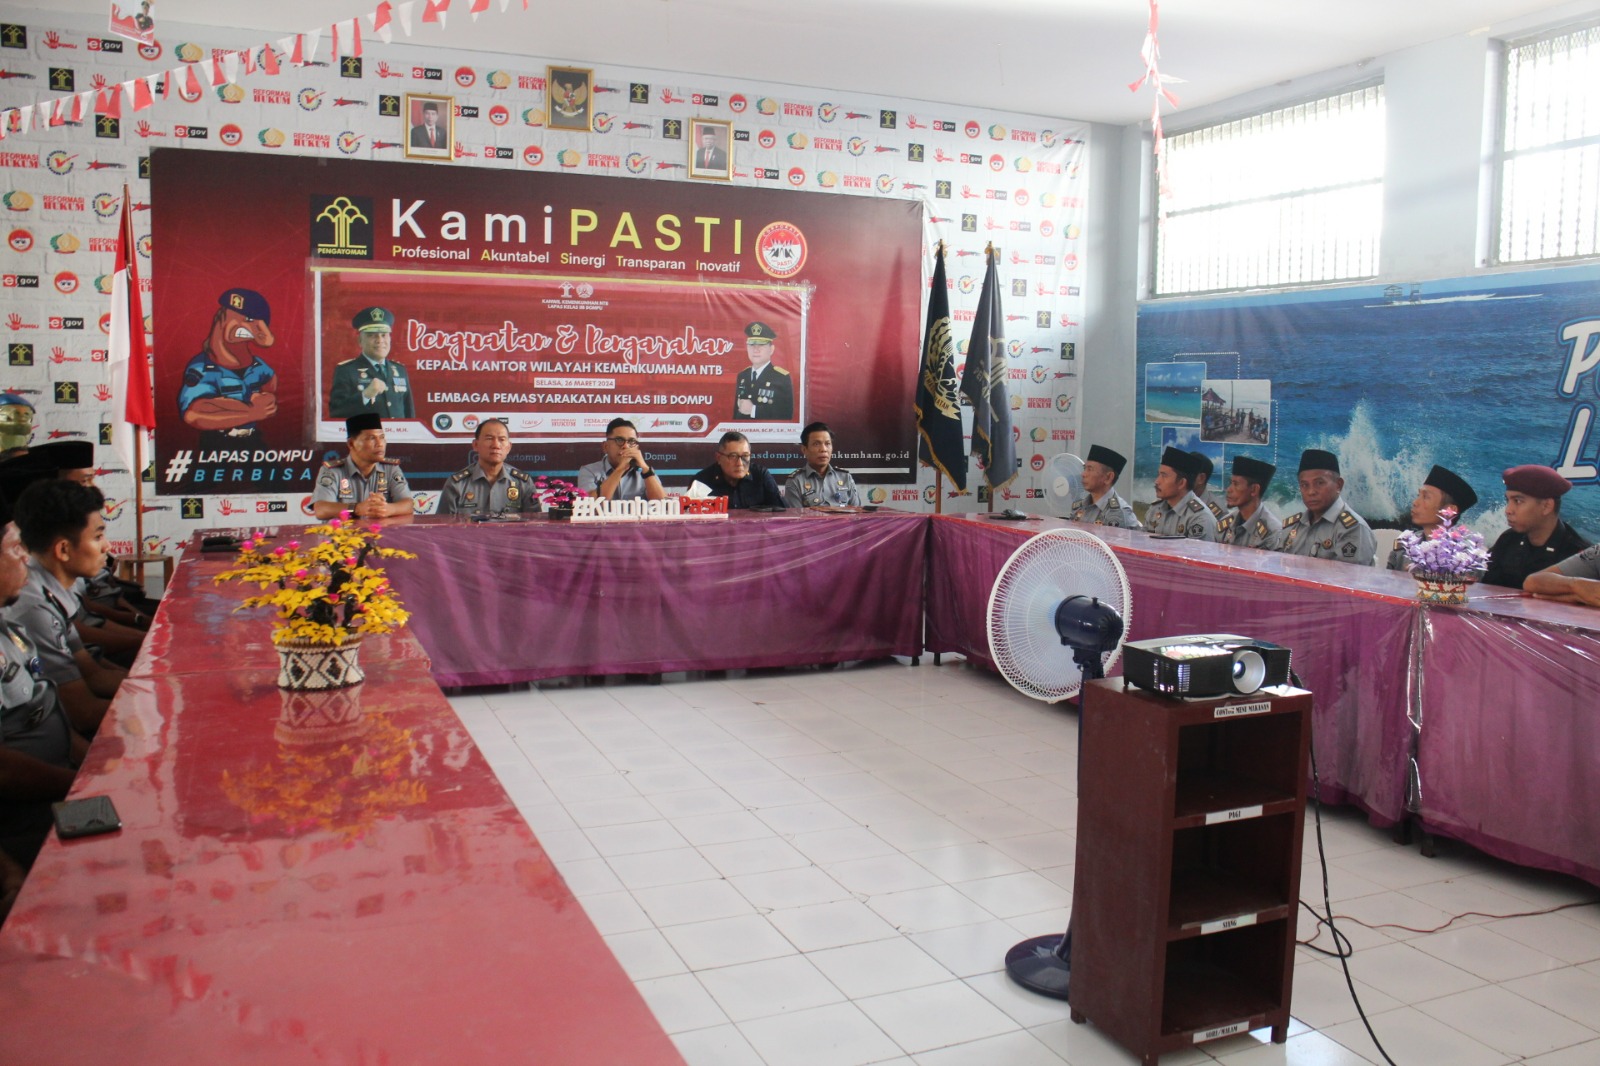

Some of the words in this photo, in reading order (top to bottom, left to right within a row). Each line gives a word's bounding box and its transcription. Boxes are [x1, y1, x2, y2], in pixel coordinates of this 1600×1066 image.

[518, 75, 547, 83] REFORMA
[518, 81, 547, 91] HUKU
[253, 88, 291, 97] REFORMASI
[253, 95, 291, 105] HUKUM
[784, 102, 813, 111] REFORMASI
[784, 109, 813, 118] HUKUM
[293, 132, 331, 141] REFORMASI
[813, 137, 843, 146] REFORMASI
[293, 139, 331, 149] HUKUM
[813, 143, 843, 152] HUKUM
[588, 153, 621, 163] REFORMASI
[588, 160, 621, 169] HUKUM
[843, 174, 872, 183] REFORMASI
[843, 180, 872, 189] HUKUM
[43, 194, 85, 204] REFORMASI
[43, 201, 85, 212] HUKUM
[392, 198, 554, 245] Kami
[570, 208, 743, 256] PASTI
[317, 247, 368, 256] PENGAYOMAN
[392, 245, 470, 261] Profesional
[480, 249, 550, 264] Akuntabel
[560, 252, 606, 268] Sinergi
[616, 255, 686, 271] Transparan
[695, 260, 741, 273] Inovatif
[416, 359, 469, 372] KEPALA
[472, 360, 527, 373] KANTOR
[530, 361, 591, 374] WILAYAH
[594, 362, 697, 376] KEMENKUMHAM
[699, 364, 723, 376] NTB
[535, 379, 564, 388] SELASA,
[598, 380, 614, 388] 2024
[427, 392, 490, 403] LEMBAGA
[493, 393, 611, 404] PEMASYARAKATAN
[614, 394, 651, 405] KELAS
[653, 395, 667, 405] IIB
[670, 395, 713, 406] DOMPU
[198, 450, 250, 464] LAPAS
[252, 449, 314, 463] DOMPU
[644, 452, 677, 463] Dompu
[193, 467, 313, 483] BERBISA
[1228, 810, 1241, 820] PAGI
